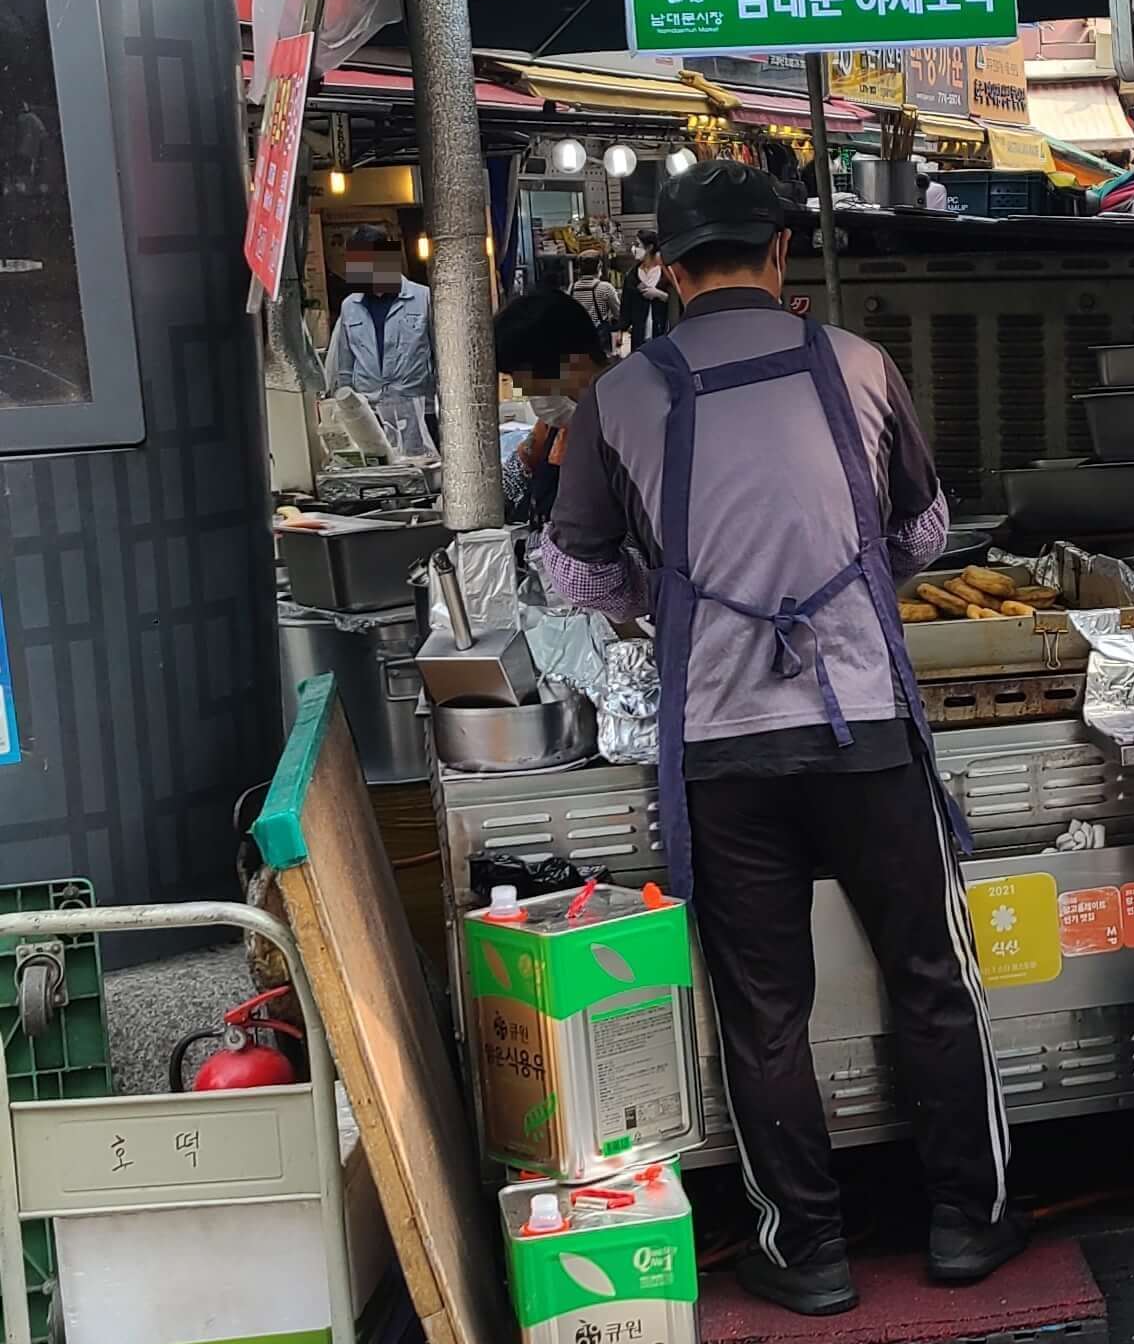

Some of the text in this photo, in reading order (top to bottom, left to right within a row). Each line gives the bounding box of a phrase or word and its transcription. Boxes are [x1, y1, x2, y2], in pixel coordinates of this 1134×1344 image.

[650, 11, 725, 27] 남대문시장
[987, 884, 1016, 897] 2021
[604, 1319, 643, 1344] 큐원
